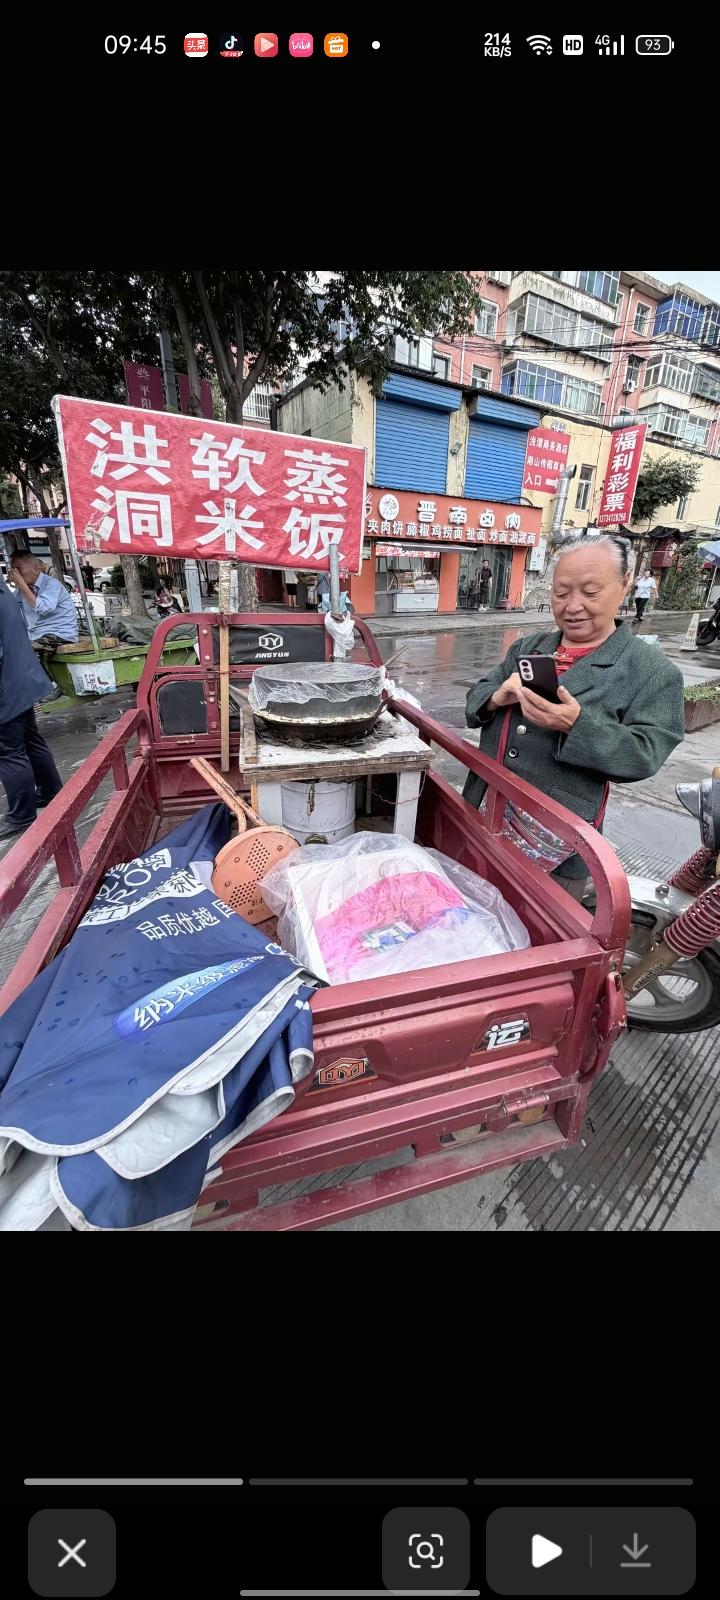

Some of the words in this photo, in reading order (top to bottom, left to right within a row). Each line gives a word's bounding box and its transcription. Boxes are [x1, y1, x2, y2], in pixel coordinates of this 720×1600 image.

[525, 472, 542, 487] 入口
[603, 430, 640, 512] 福利彩票
[417, 499, 521, 530] 晋南卤肉
[136, 907, 220, 941] 品质优越
[486, 1019, 526, 1051] 运
